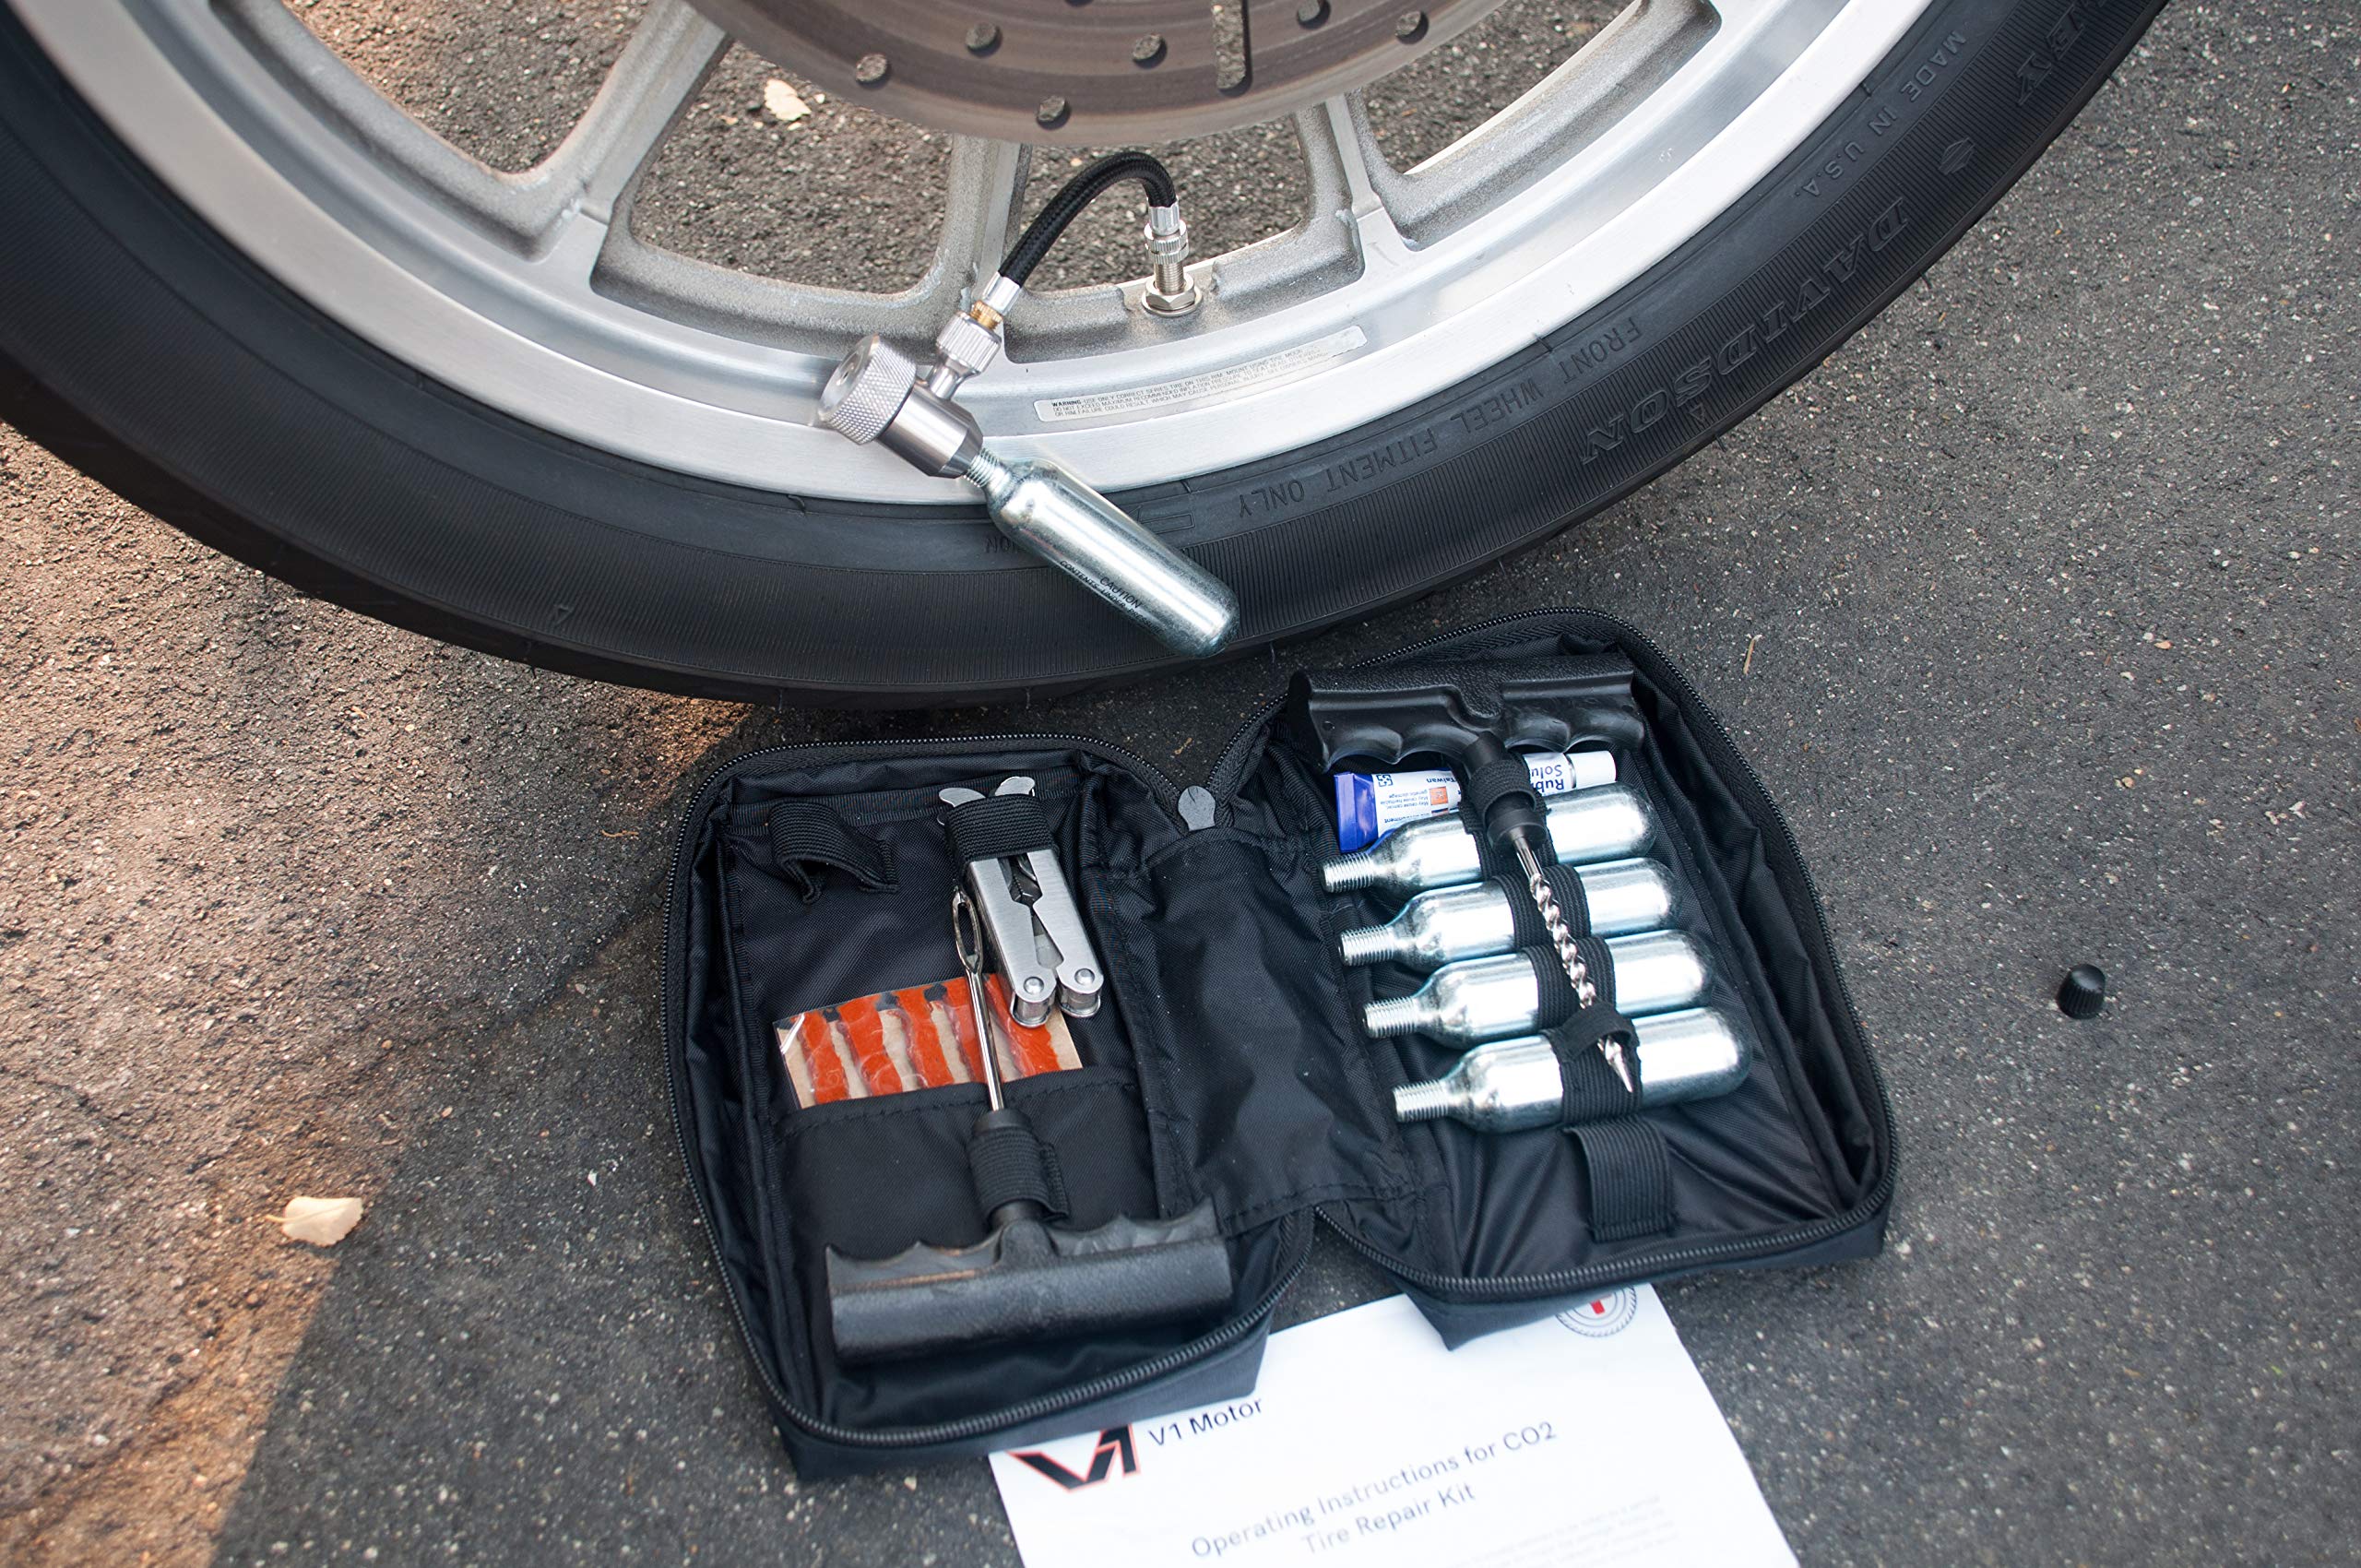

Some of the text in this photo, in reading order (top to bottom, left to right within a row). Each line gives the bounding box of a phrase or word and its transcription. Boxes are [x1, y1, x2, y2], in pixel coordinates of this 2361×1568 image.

[1900, 30, 1966, 102] MADE
[1868, 106, 1899, 136] IN
[1581, 196, 1908, 464] DAVIDSON
[1238, 315, 1643, 517] FRONT WHEEL FITMENT ONLY
[1060, 560, 1098, 588] CONTENTS
[1101, 589, 1125, 608] UNDER
[1099, 576, 1142, 609] CAUTION
[1149, 1398, 1263, 1446] V1 Motor
[1192, 1421, 1558, 1558] Operating Instructions for CO2
[1301, 1483, 1476, 1554] Tire Repair Kit
